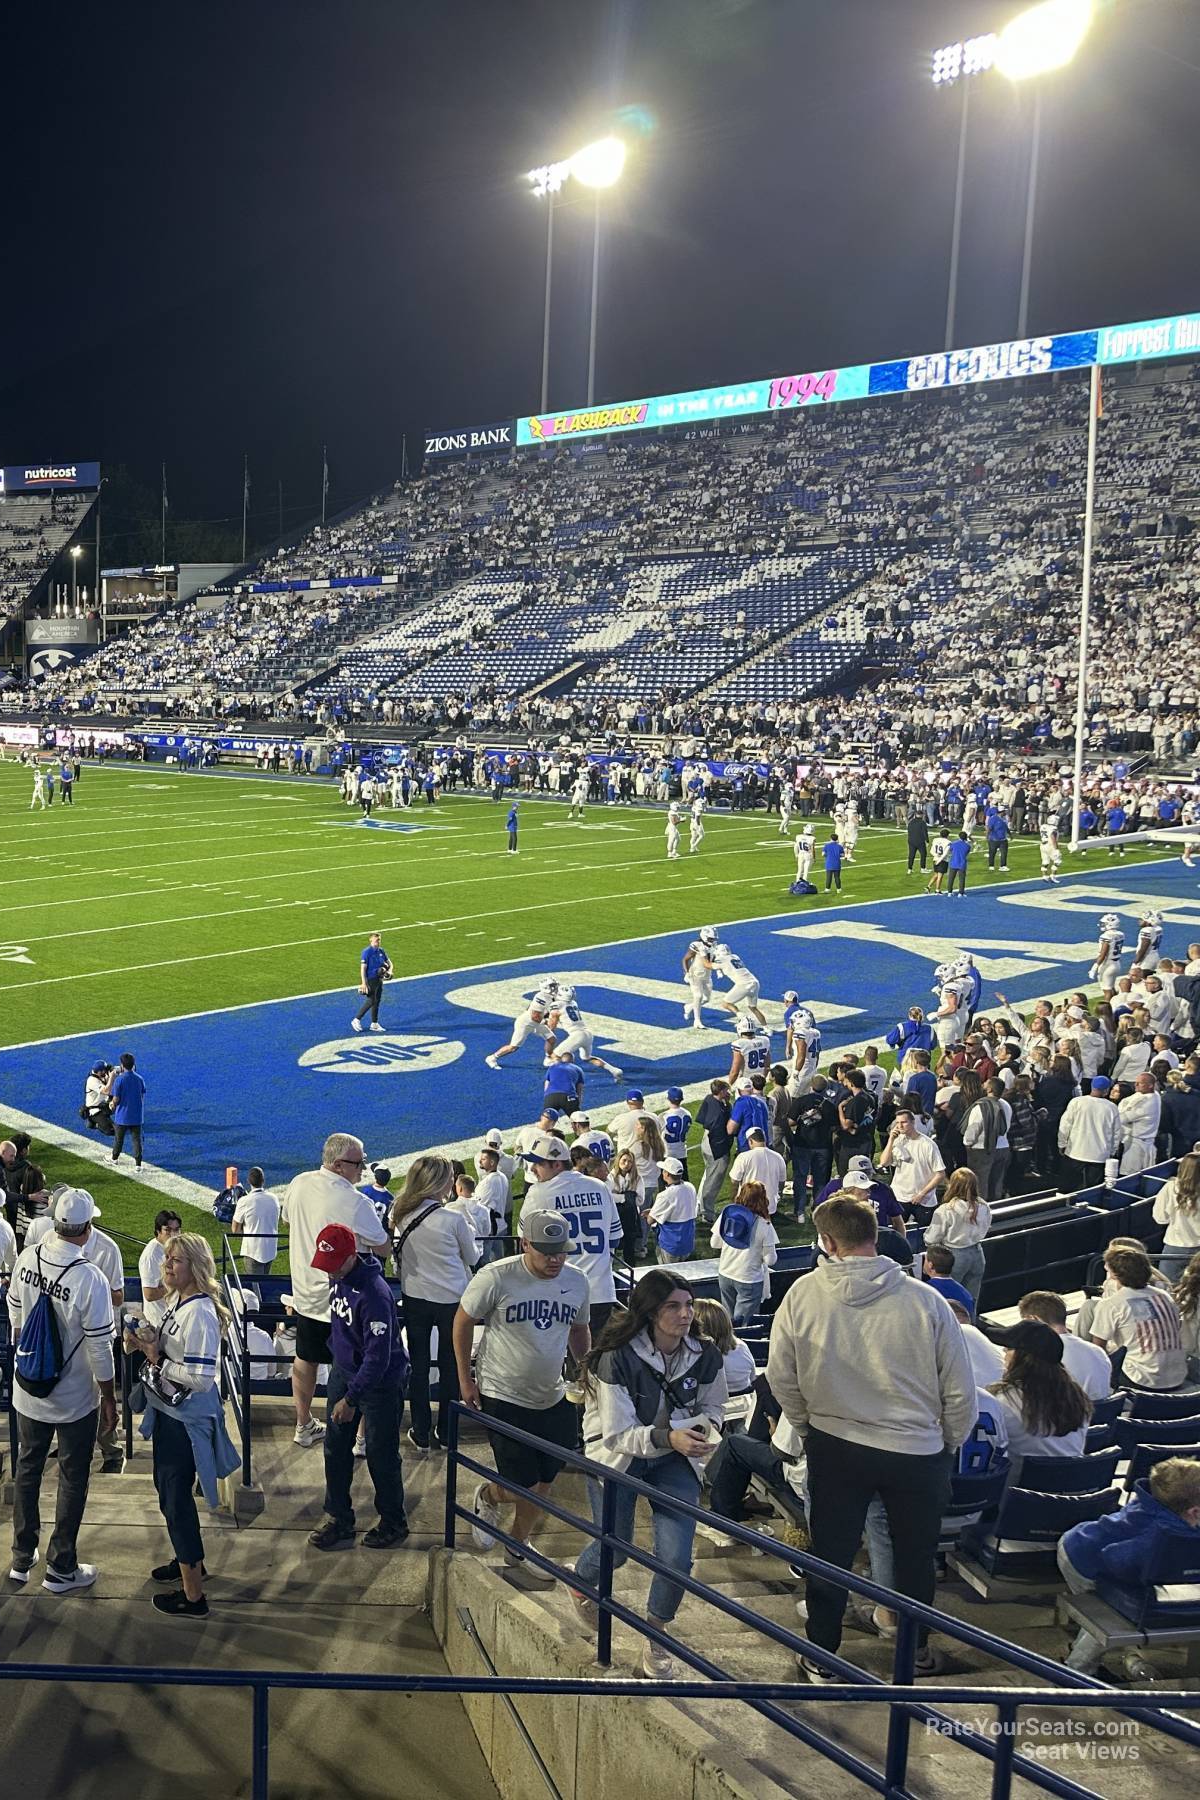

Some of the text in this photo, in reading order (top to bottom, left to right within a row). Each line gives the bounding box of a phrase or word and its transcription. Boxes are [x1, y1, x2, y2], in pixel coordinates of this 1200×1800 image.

[1102, 317, 1174, 360] Forrest
[905, 337, 1053, 391] GO COUGS
[767, 370, 838, 408] 1994
[657, 390, 758, 418] IN THE YEAR
[553, 404, 642, 435] FLASHBACK
[425, 427, 511, 454] ZIONS BANK
[684, 431, 697, 441] 42
[24, 465, 78, 480] nutricost
[232, 740, 254, 750] BYU
[934, 845, 944, 856] 19
[747, 1049, 766, 1069] 85
[871, 1081, 879, 1092] 7
[554, 1192, 604, 1210] ALLGEIER
[20, 1266, 71, 1302] COUGARS
[505, 1299, 578, 1326] COUGARS
[960, 1411, 997, 1475] 6
